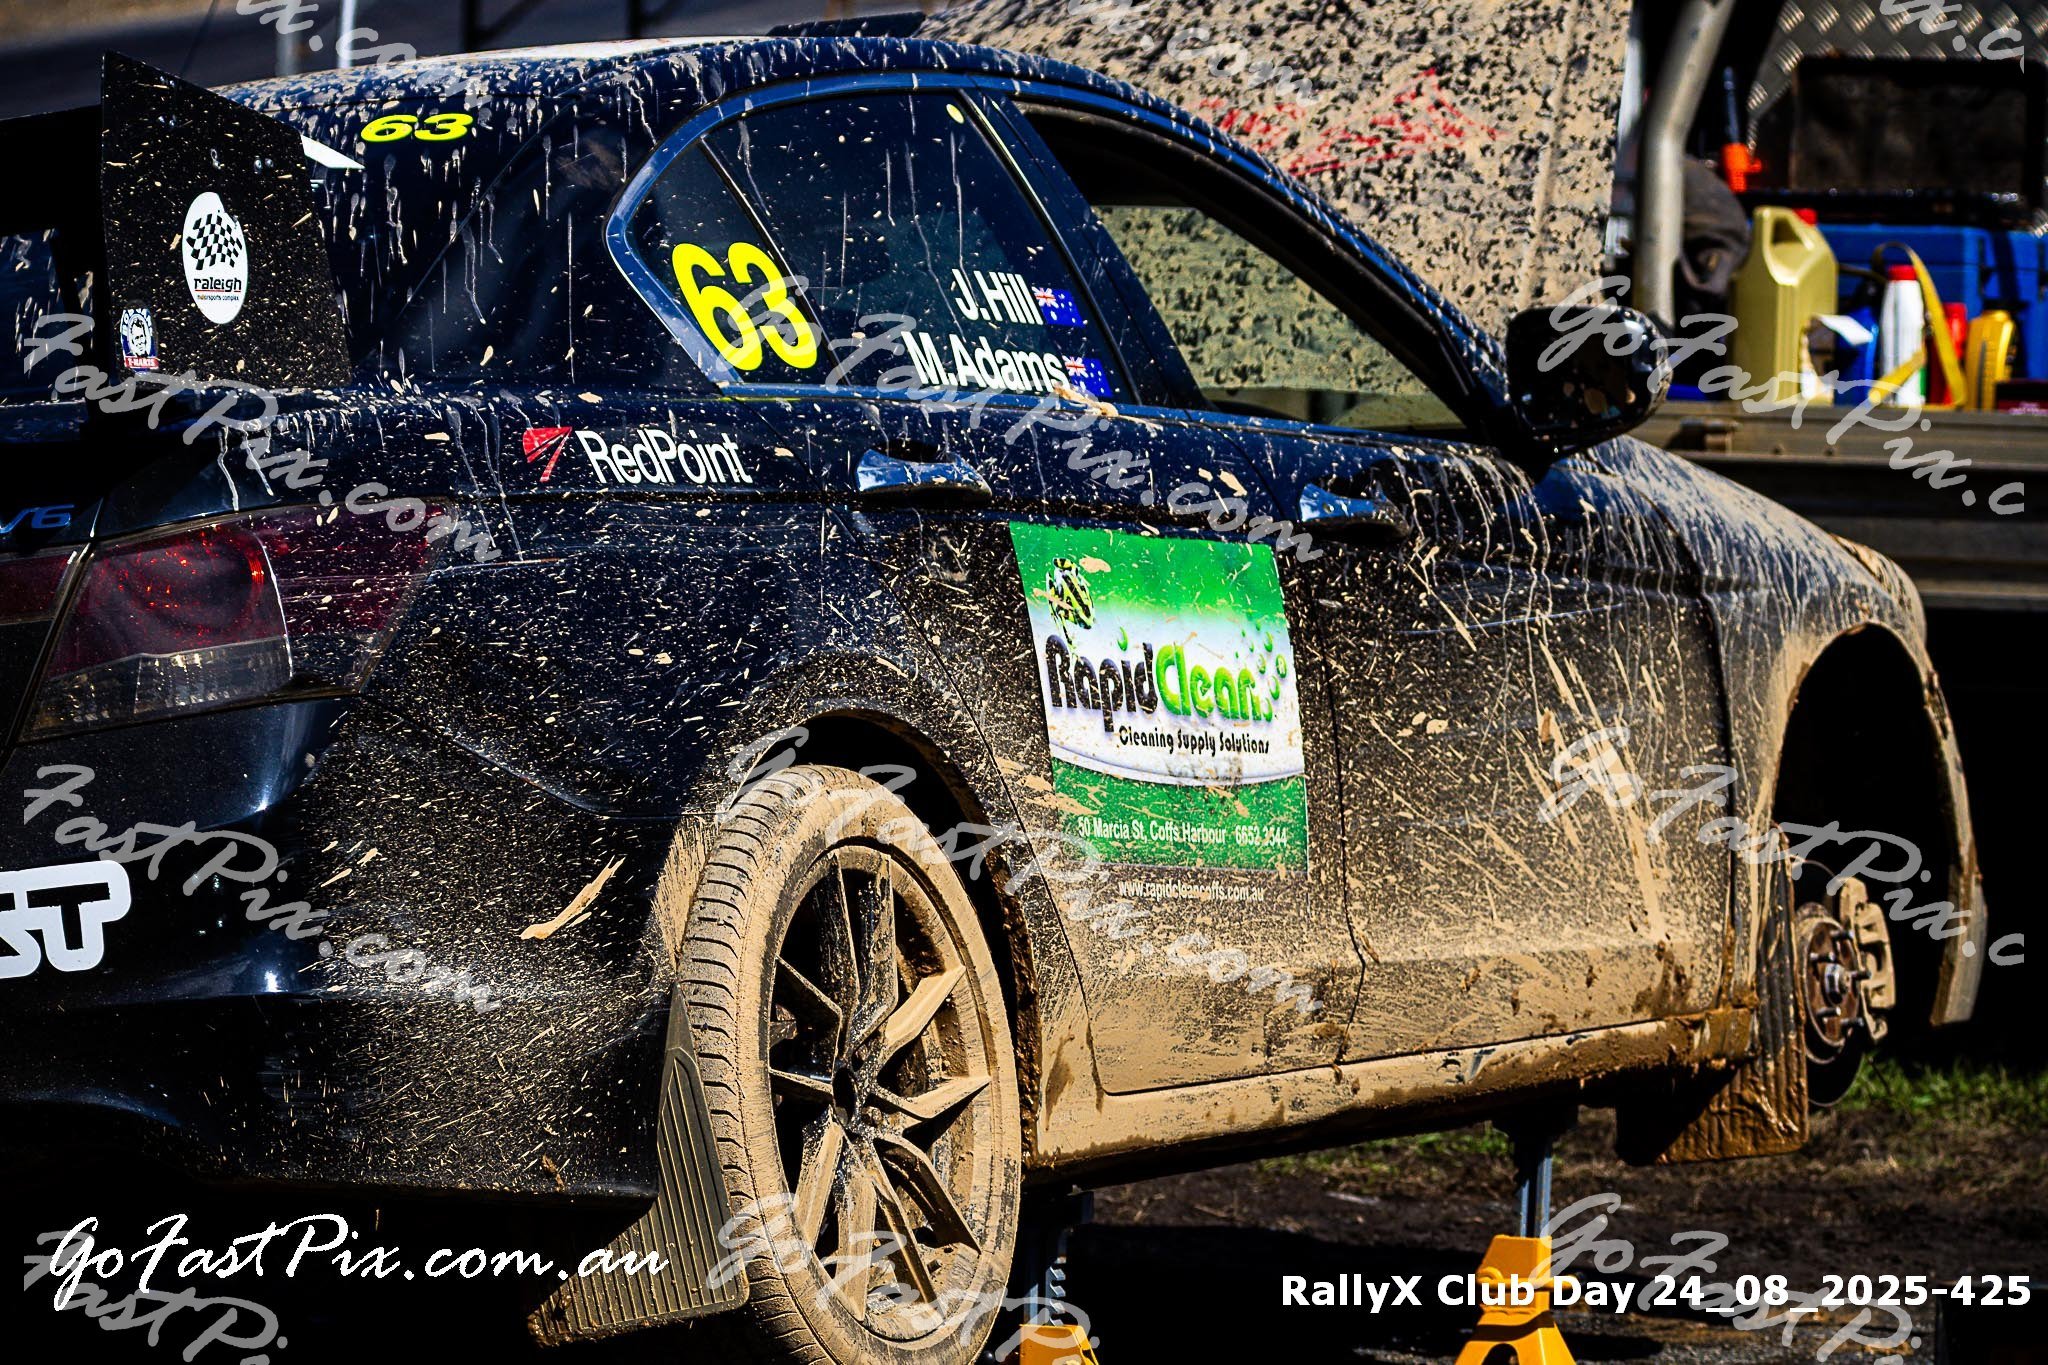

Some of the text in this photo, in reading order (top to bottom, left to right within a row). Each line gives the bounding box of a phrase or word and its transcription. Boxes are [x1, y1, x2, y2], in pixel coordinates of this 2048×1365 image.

[361, 113, 473, 142] 63
[193, 276, 242, 293] raleigh
[672, 242, 817, 371] 63
[951, 268, 1044, 326] J.Hill
[901, 330, 1070, 392] M.Adams
[575, 428, 753, 484] RedPoint
[1045, 634, 1262, 733] RapidClean
[1119, 725, 1270, 757] Cleaning Supply Solutions
[1077, 816, 1091, 837] 50
[1093, 817, 1131, 841] Marcia
[1132, 819, 1148, 844] St,
[1149, 820, 1180, 842] Coffs
[1182, 822, 1227, 845] Harbour
